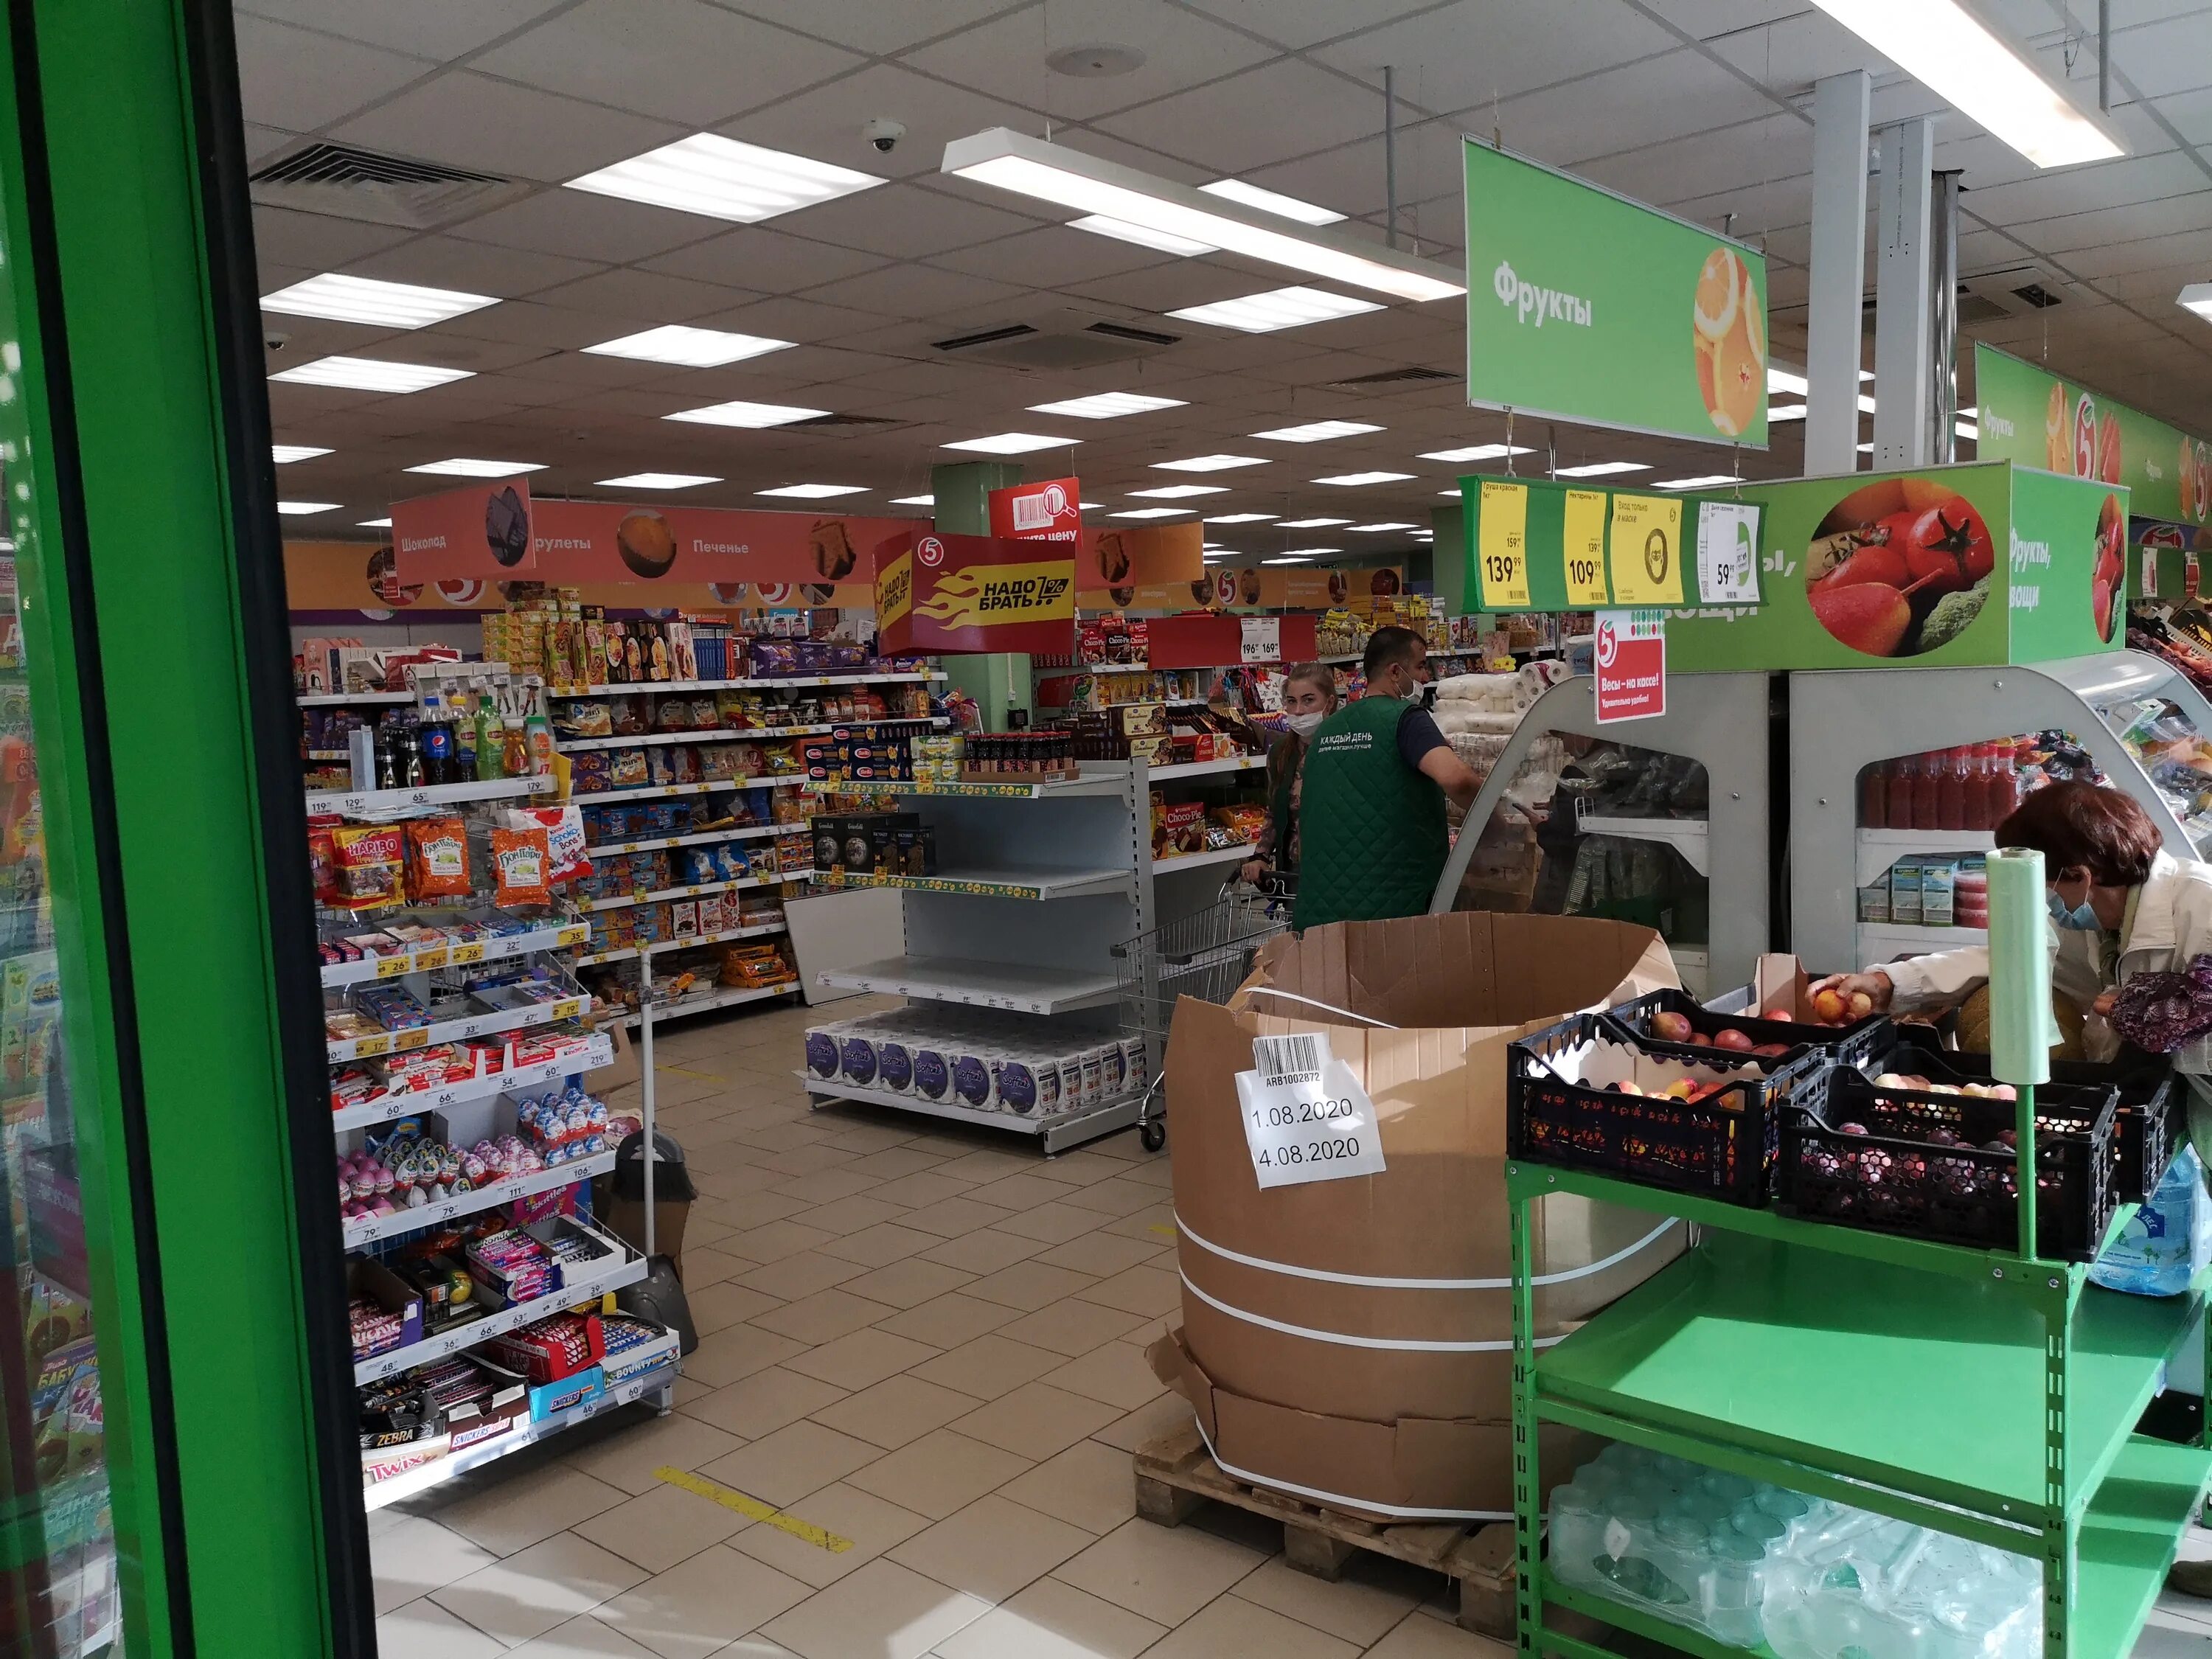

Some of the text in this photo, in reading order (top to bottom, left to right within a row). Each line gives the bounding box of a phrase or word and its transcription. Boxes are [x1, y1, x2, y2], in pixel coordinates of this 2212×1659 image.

[1494, 260, 1591, 327] Фрукты
[1484, 482, 1518, 493] Груша красная
[1618, 501, 1631, 512] Вход
[1048, 530, 1077, 542] цену
[401, 535, 447, 553] Шоколад
[535, 538, 591, 553] рулеты
[692, 540, 749, 554] Печенье
[1506, 538, 1517, 548] 159
[1588, 543, 1597, 553] 139
[1486, 555, 1521, 582] 139 99
[1570, 560, 1601, 585] 109 99
[1717, 563, 1729, 585] 59
[985, 580, 1036, 596] НАДО
[979, 597, 1033, 611] БРАТЬ
[2009, 585, 2039, 613] вощи
[1242, 643, 1255, 654] 196
[1262, 643, 1275, 653] 169
[1601, 677, 1621, 692] Весы
[1627, 679, 1635, 689] на
[1637, 673, 1659, 689] кассе!
[1320, 731, 1373, 745] КАЖДЫЙ ДЕНЬ
[526, 782, 540, 790] 179
[412, 792, 424, 801] 65
[311, 802, 326, 811] 119
[345, 799, 360, 807] 129
[349, 839, 397, 856] HARIBO
[559, 838, 578, 850] Bons
[507, 942, 516, 950] 22
[467, 950, 478, 958] 26
[393, 961, 405, 971] 26
[524, 1014, 535, 1022] 47
[465, 1026, 475, 1034] 33
[374, 1043, 383, 1051] 17
[591, 1055, 604, 1064] 219
[546, 1067, 556, 1076] 60
[502, 1078, 512, 1087] 54
[1266, 1072, 1321, 1088] ARB1002872
[439, 1094, 451, 1103] 66
[387, 1106, 399, 1115] 60
[1252, 1098, 1353, 1129] 1.08.2020
[1259, 1138, 1360, 1167] 4.08.2020
[574, 1167, 588, 1177] 106
[509, 1189, 522, 1197] 111
[443, 1206, 454, 1215] 79
[364, 1228, 375, 1238] 79
[481, 1231, 511, 1247] Rondo
[591, 1285, 600, 1294] 39
[557, 1298, 567, 1306] 49
[512, 1315, 524, 1324] 63
[480, 1326, 492, 1336] 66
[444, 1340, 455, 1349] 36
[381, 1363, 394, 1372] 48
[616, 1358, 651, 1380] BOUNTY
[629, 1387, 639, 1396] 60
[552, 1391, 580, 1408] SNICKERS
[582, 1405, 593, 1413] 46
[377, 1429, 414, 1447] ZEBRA
[453, 1426, 490, 1446] SNICKERS
[367, 1455, 424, 1482] Twix
